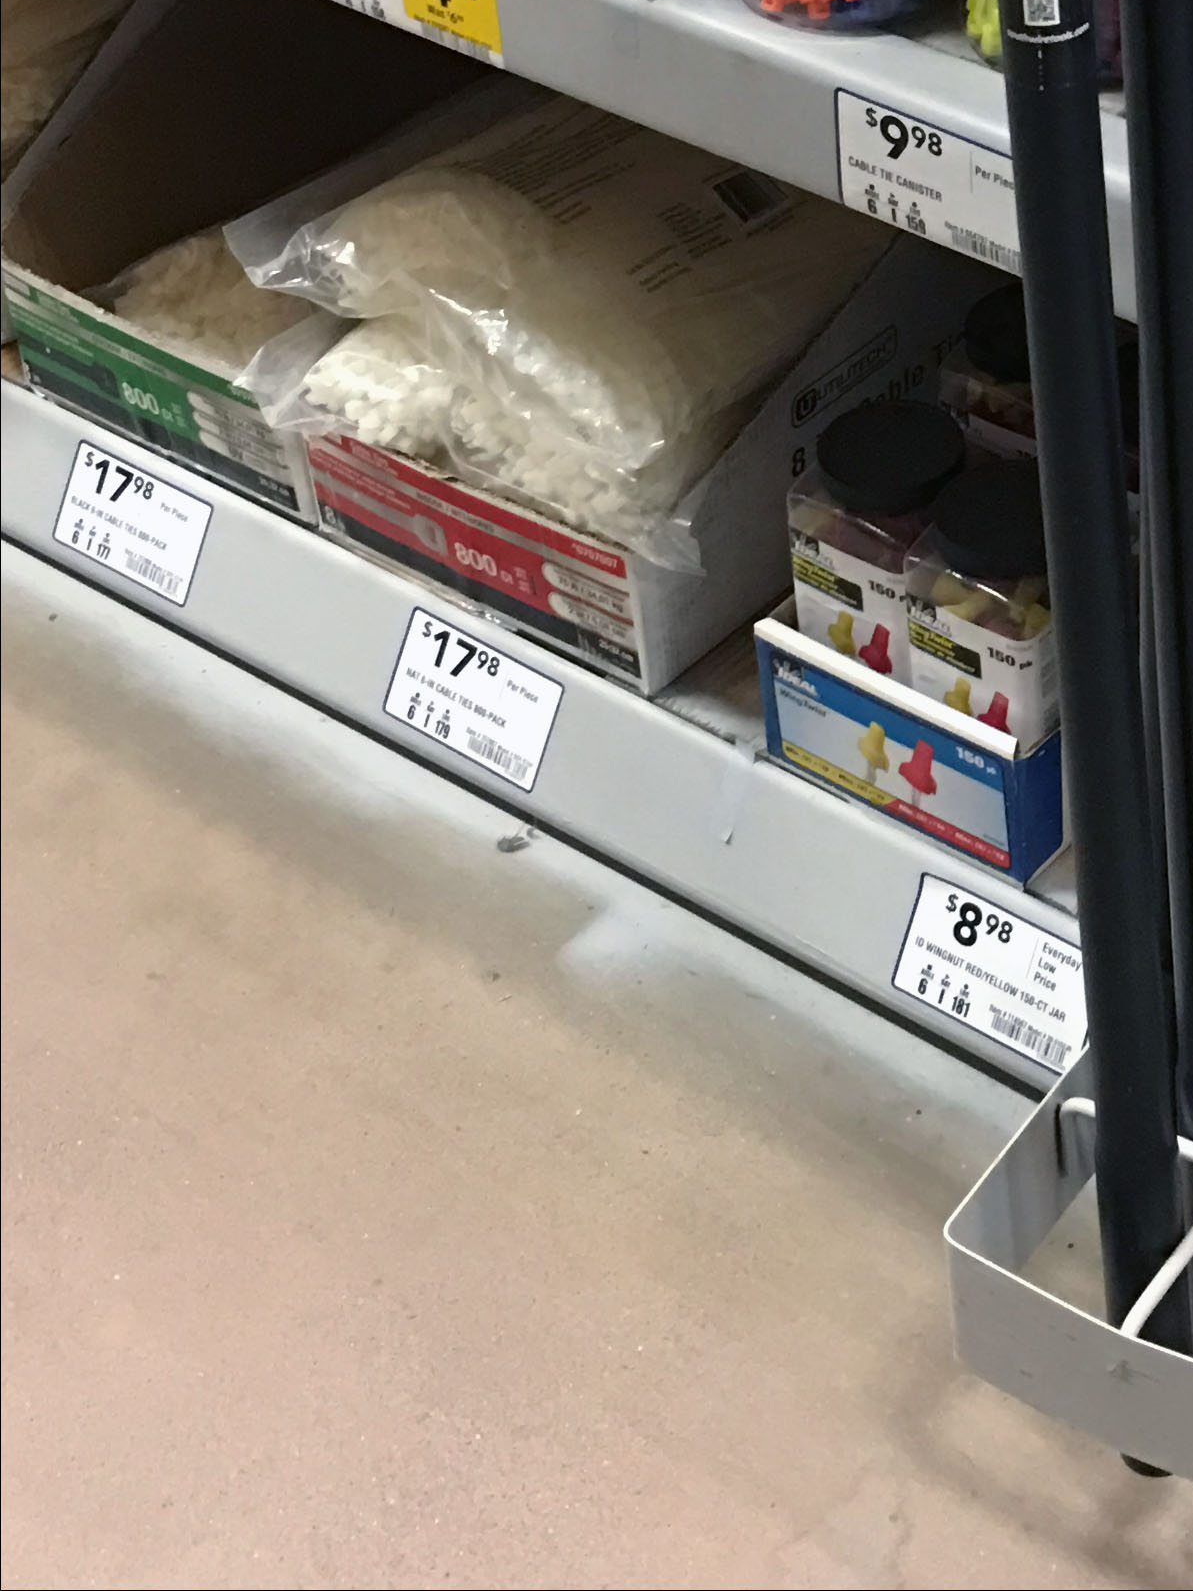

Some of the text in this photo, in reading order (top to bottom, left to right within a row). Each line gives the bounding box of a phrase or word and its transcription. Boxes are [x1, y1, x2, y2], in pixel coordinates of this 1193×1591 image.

[848, 156, 942, 201] CABLE TIE CANISTER
[975, 166, 991, 179] Per
[122, 382, 160, 415] 800
[104, 512, 124, 528] CABLE
[125, 524, 137, 536] TIES
[454, 541, 497, 576] 800
[868, 579, 896, 599] 150
[988, 647, 1016, 667] 150
[406, 667, 420, 681] NAT
[436, 681, 456, 701] CABLE
[458, 694, 473, 709] TIES
[956, 745, 984, 769] 150
[1038, 957, 1056, 974] Low
[1042, 942, 1082, 972] Everyday
[915, 936, 1066, 1023] ID WINGNUT RED/YELLOW 150-CT JAR
[1033, 972, 1057, 991] Price
[952, 996, 970, 1017] 181
